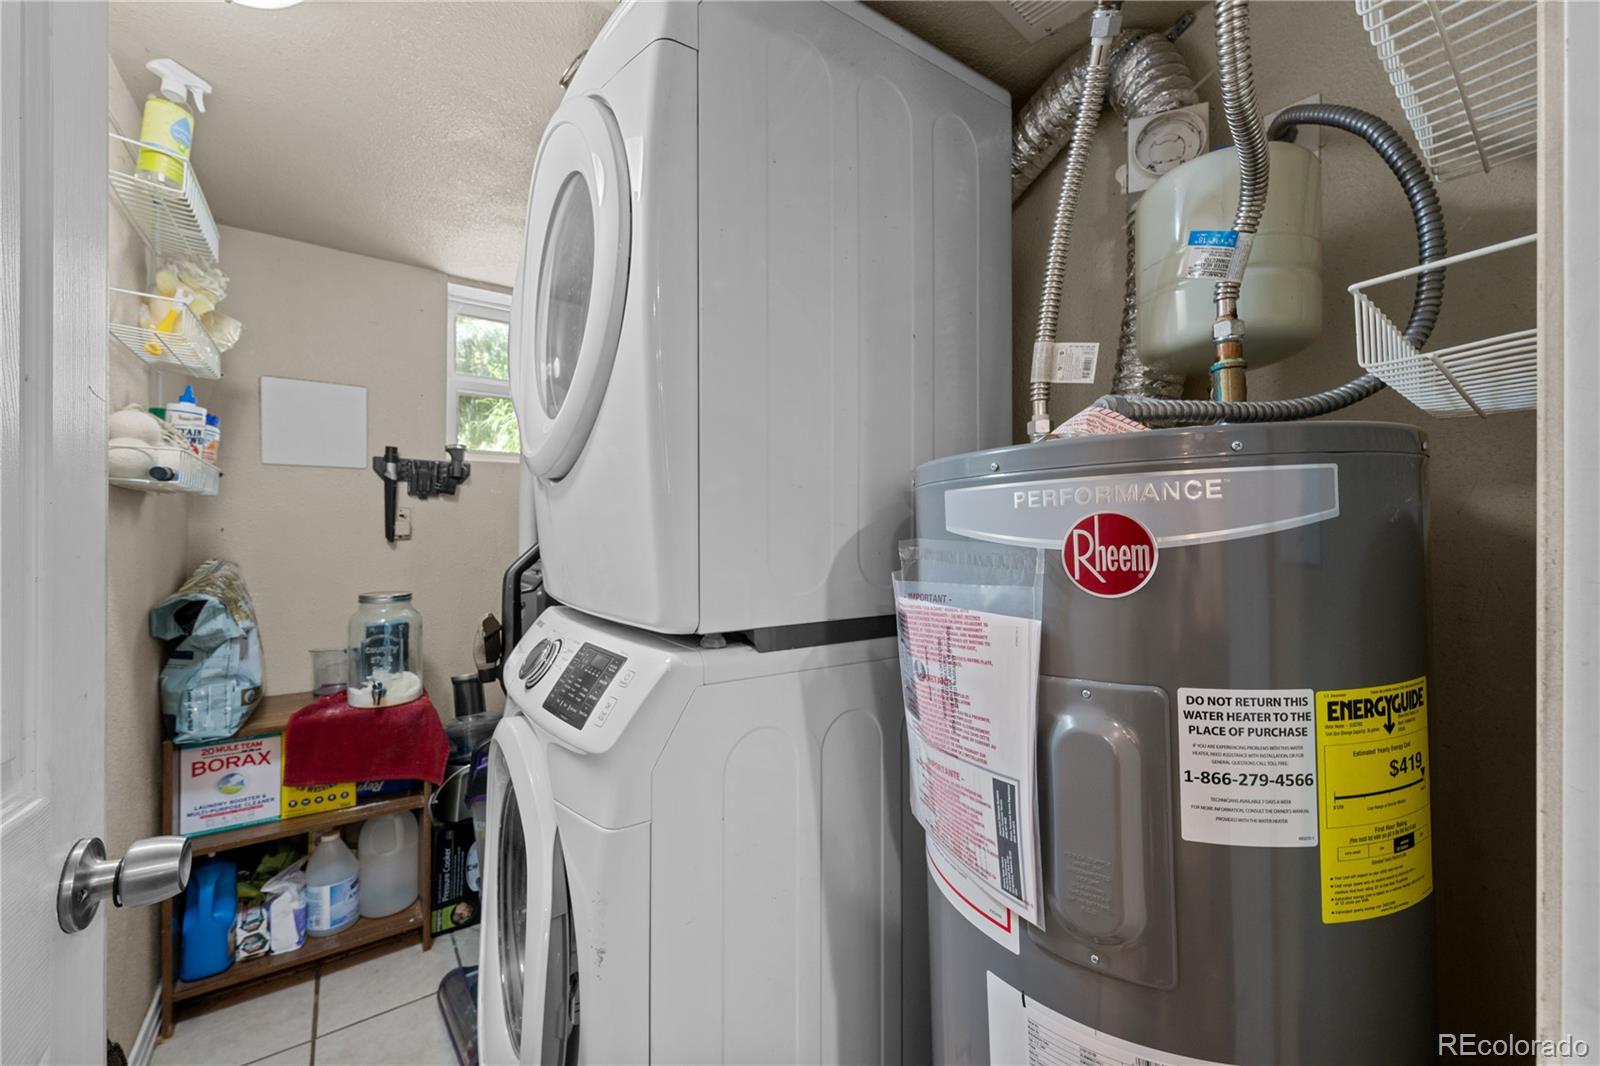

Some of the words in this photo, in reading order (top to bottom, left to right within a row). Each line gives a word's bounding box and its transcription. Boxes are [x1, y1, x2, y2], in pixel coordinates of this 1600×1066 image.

[1014, 478, 1224, 509] PERFORMANCE
[1072, 514, 1150, 584] Rheem
[908, 593, 947, 603] IMPORTANT
[1186, 695, 1204, 705] DO
[1208, 696, 1232, 706] NOT
[1235, 697, 1281, 707] RETURN
[1285, 697, 1308, 707] THIS
[1327, 687, 1424, 722] ENERGYGUIDE
[1183, 710, 1224, 721] WATER
[1227, 712, 1272, 721] HEATER
[1274, 712, 1288, 721] TO
[1290, 712, 1312, 721] THE
[1188, 725, 1226, 736] PLACE
[1229, 727, 1245, 736] OF
[1248, 727, 1308, 737] PURCHASE
[215, 744, 239, 754] MULE
[192, 751, 271, 778] BORAX
[1390, 752, 1422, 778] $419
[1184, 770, 1314, 787] 1-866-279-4566
[186, 804, 242, 817] MULTI-PURPOSE
[243, 798, 275, 807] CLEANER
[193, 800, 227, 811] LAUNDRY
[228, 795, 259, 805] BOOSTER
[443, 848, 451, 872] Cooker
[442, 871, 450, 902] Pressure
